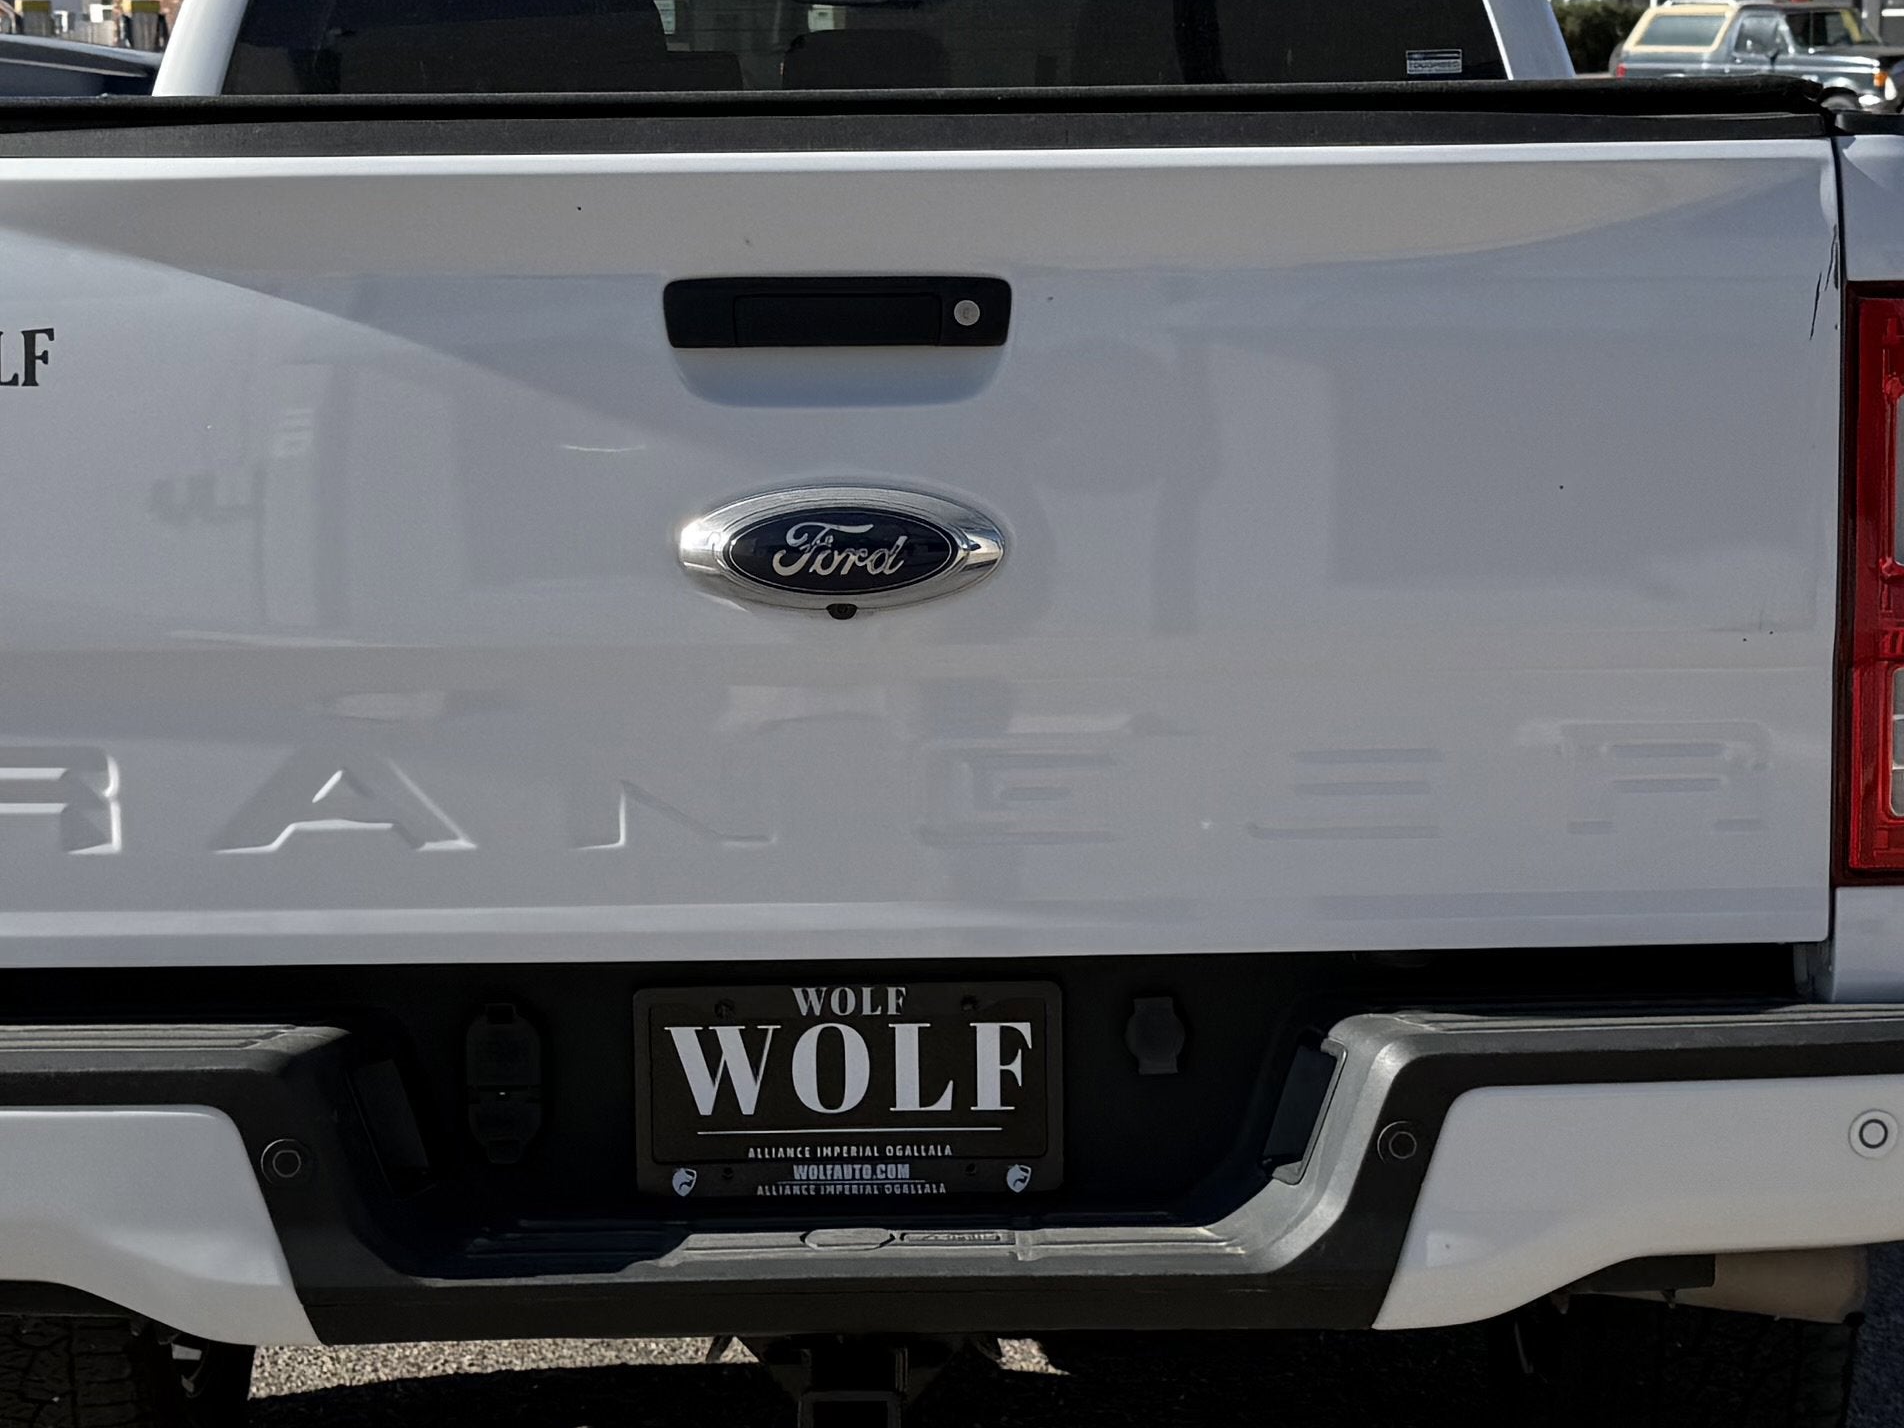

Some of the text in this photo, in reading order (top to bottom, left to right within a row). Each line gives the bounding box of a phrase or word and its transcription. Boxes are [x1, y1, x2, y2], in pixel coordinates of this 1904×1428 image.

[772, 522, 908, 577] Ford
[792, 987, 907, 1017] WOLF
[664, 1022, 1033, 1116] WOLF
[748, 1144, 953, 1159] ALLIANCE IMPERIAL OGALLALA
[793, 1163, 911, 1181] WOLFAUTO.COM
[757, 1183, 947, 1196] ALLIANCE IMPERIAL OGALLALA
